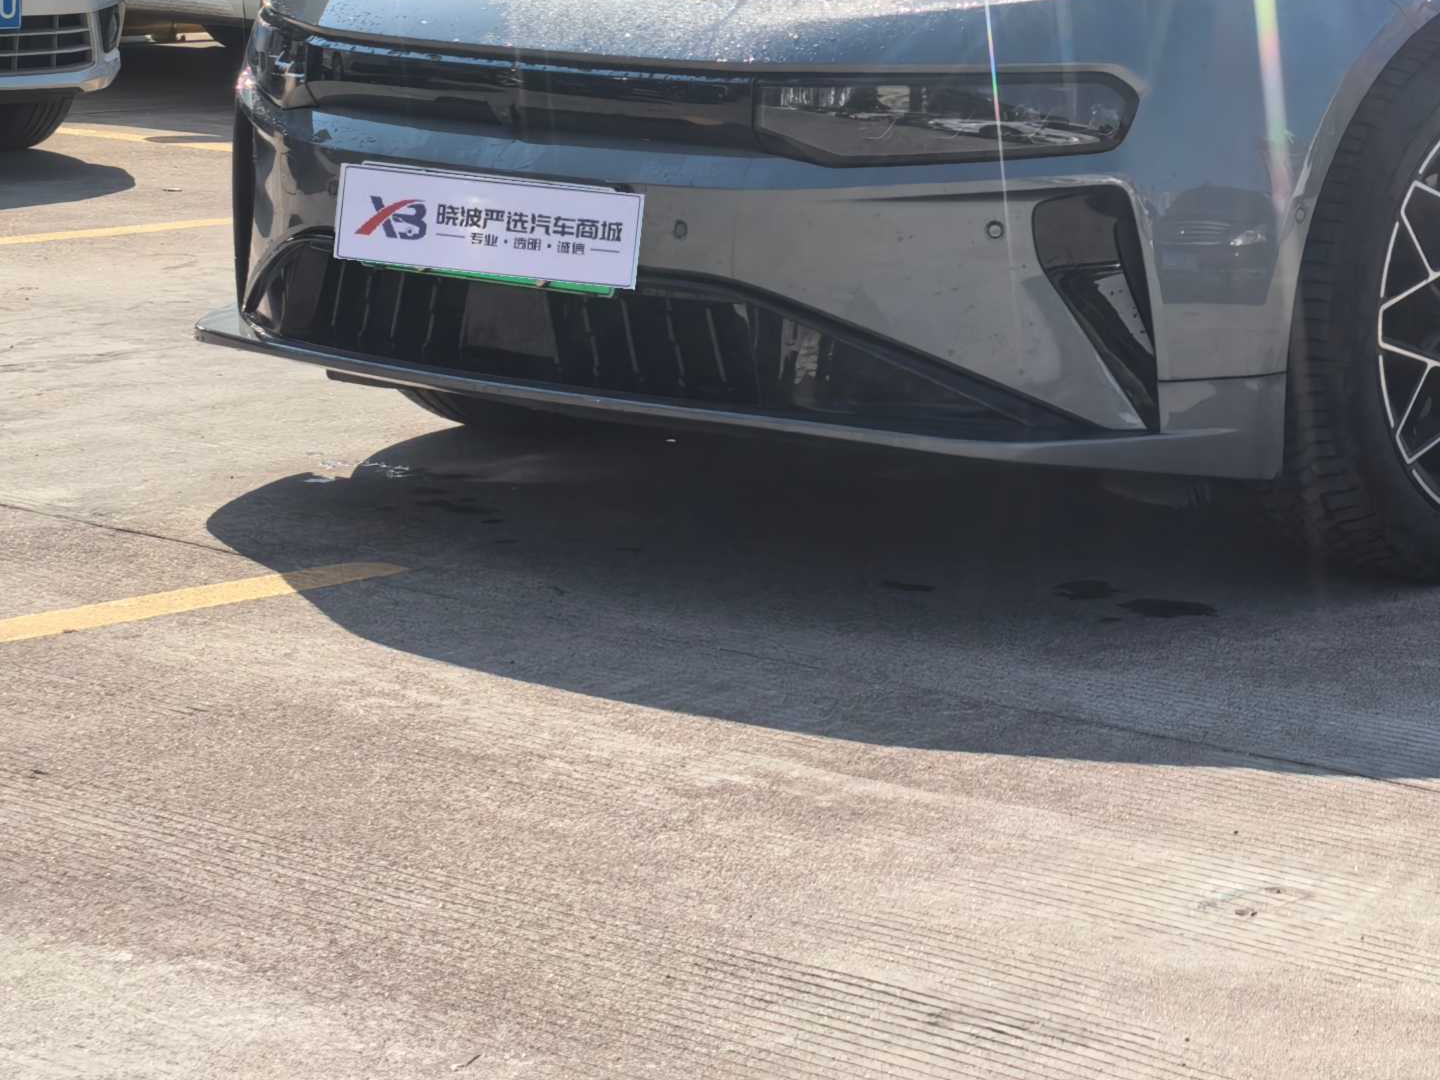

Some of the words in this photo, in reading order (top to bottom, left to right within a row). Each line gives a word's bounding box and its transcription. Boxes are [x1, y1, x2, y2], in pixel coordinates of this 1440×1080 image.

[436, 203, 624, 243] 晓波严选汽车商城
